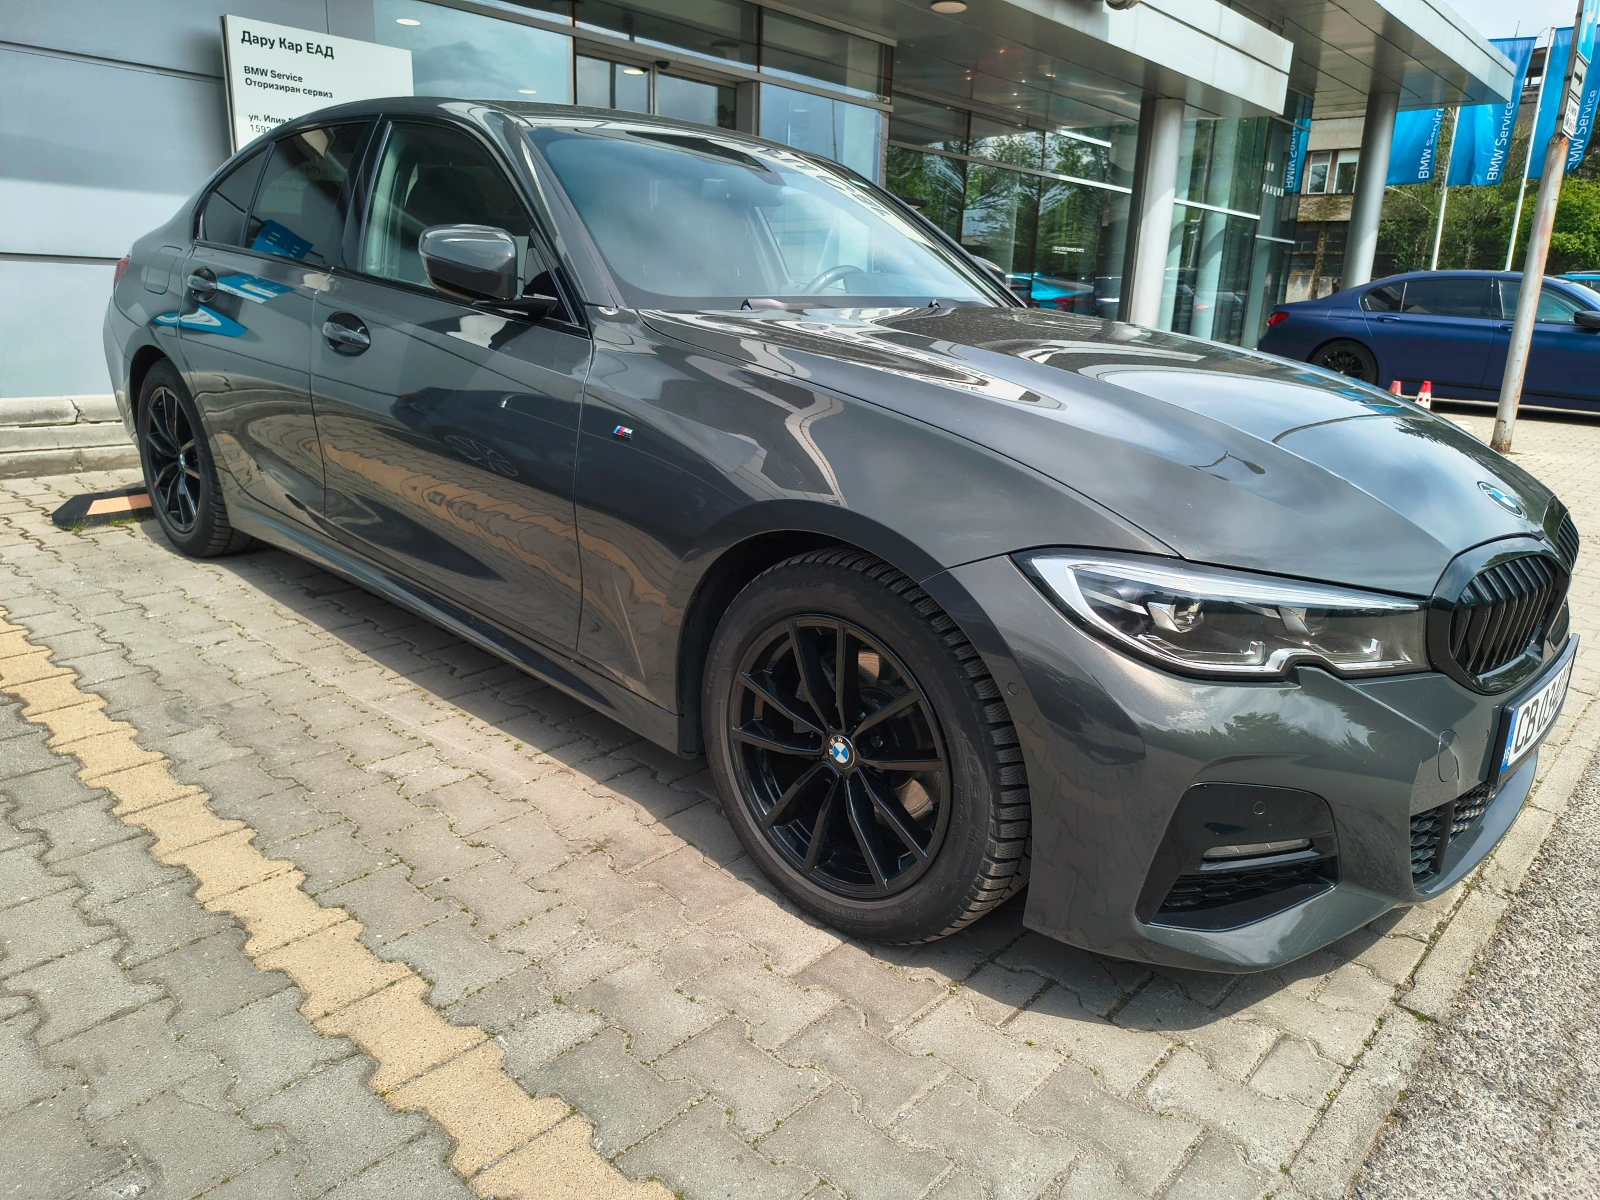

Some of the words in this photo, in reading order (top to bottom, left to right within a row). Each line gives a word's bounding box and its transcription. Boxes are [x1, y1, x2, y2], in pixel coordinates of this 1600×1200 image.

[241, 30, 275, 49] Дару
[278, 37, 303, 53] Кар
[306, 42, 335, 60] ЕАД
[244, 65, 269, 78] BMW
[270, 69, 303, 83] Service
[244, 77, 301, 94] Оторизиран
[302, 88, 334, 99] сервиз
[1495, 102, 1514, 146] Service
[1574, 90, 1597, 135] Service
[1418, 148, 1432, 179] BMW
[1487, 149, 1504, 181] BMW
